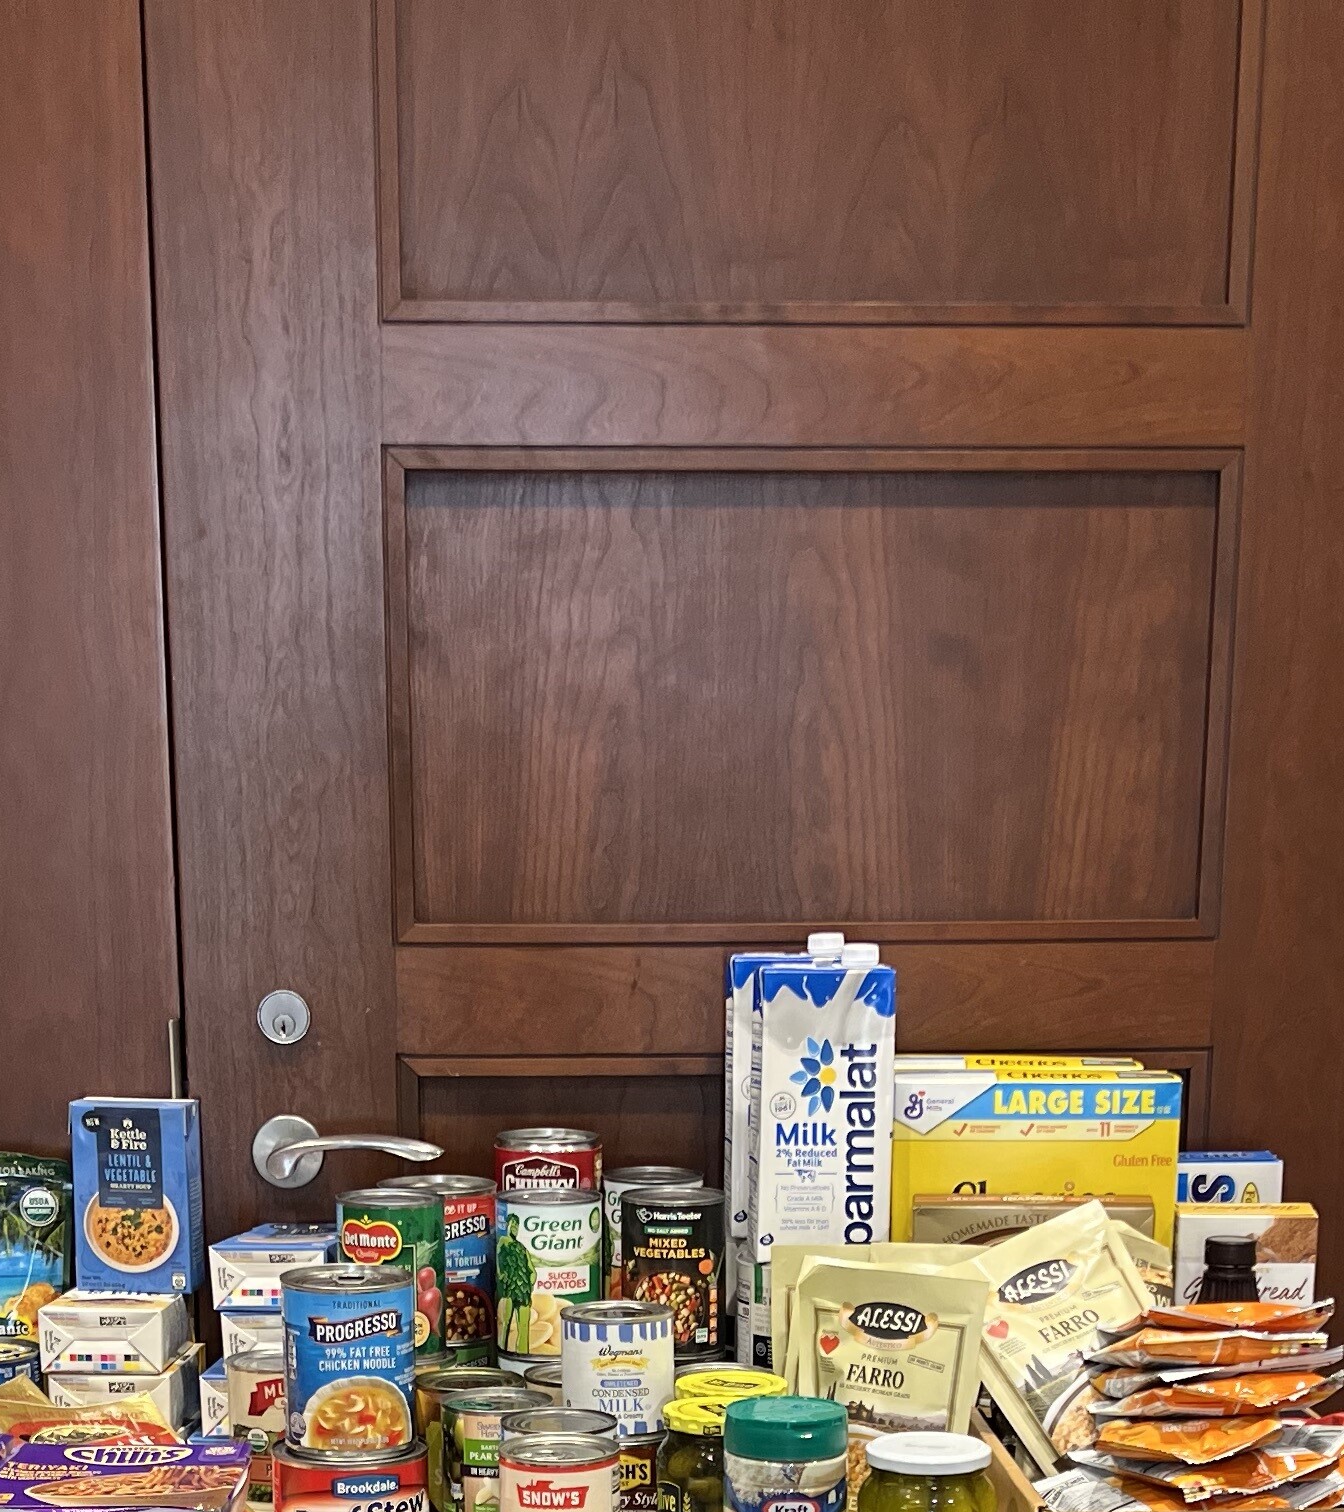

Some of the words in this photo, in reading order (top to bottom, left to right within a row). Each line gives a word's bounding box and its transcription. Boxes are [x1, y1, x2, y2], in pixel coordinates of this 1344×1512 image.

[993, 1090, 1083, 1115] LARGE
[1095, 1090, 1155, 1115] SIZE
[110, 1129, 146, 1140] Kettle
[776, 1123, 836, 1146] Milk
[110, 1140, 119, 1149] &
[122, 1140, 147, 1150] Fire
[840, 1043, 877, 1244] parmalat
[776, 1149, 793, 1157] 2%
[796, 1149, 837, 1157] Reduced
[109, 1154, 141, 1167] LENTIL
[146, 1154, 151, 1167] &
[787, 1159, 801, 1167] Fat
[803, 1158, 822, 1167] Milk
[1113, 1155, 1148, 1167] Gluten
[1152, 1155, 1172, 1166] Free
[20, 1166, 54, 1176] BAKING
[105, 1169, 156, 1182] VEGETABLE
[515, 1163, 561, 1178] Campbell's
[505, 1174, 574, 1189] CHUNKY
[28, 1196, 49, 1206] USDA
[654, 1211, 676, 1222] Harris
[678, 1211, 701, 1221] Teeter
[445, 1215, 486, 1240] GRESSO
[524, 1216, 582, 1234] Green
[345, 1231, 359, 1246] Del
[360, 1233, 397, 1248] Monte
[531, 1234, 583, 1250] Giant
[649, 1237, 687, 1248] MIXED
[633, 1246, 705, 1259] VEGETABLES
[455, 1256, 486, 1268] TORTILLA
[548, 1271, 577, 1281] SLICED
[1003, 1261, 1071, 1300] ALESSI
[536, 1278, 587, 1290] POTATOES
[332, 1301, 381, 1309] TRADITIONAL
[857, 1307, 922, 1333] ALESSI
[1039, 1305, 1077, 1322] PREMIUM
[316, 1312, 397, 1343] PROGRESSO
[1038, 1309, 1100, 1344] FARRO
[325, 1348, 347, 1359] 99%
[350, 1348, 367, 1358] FAT
[370, 1346, 390, 1357] FREE
[599, 1345, 642, 1361] Wegmans
[861, 1353, 898, 1365] PREMIUM
[319, 1359, 360, 1371] CHICKEN
[363, 1358, 396, 1370] NOODLE
[846, 1364, 904, 1389] FARRO
[592, 1388, 649, 1397] CONDENSED
[599, 1399, 644, 1412] MILK
[469, 1451, 492, 1460] PEAR
[337, 1480, 397, 1494] Brookdale
[523, 1490, 580, 1506] SNOW'S
